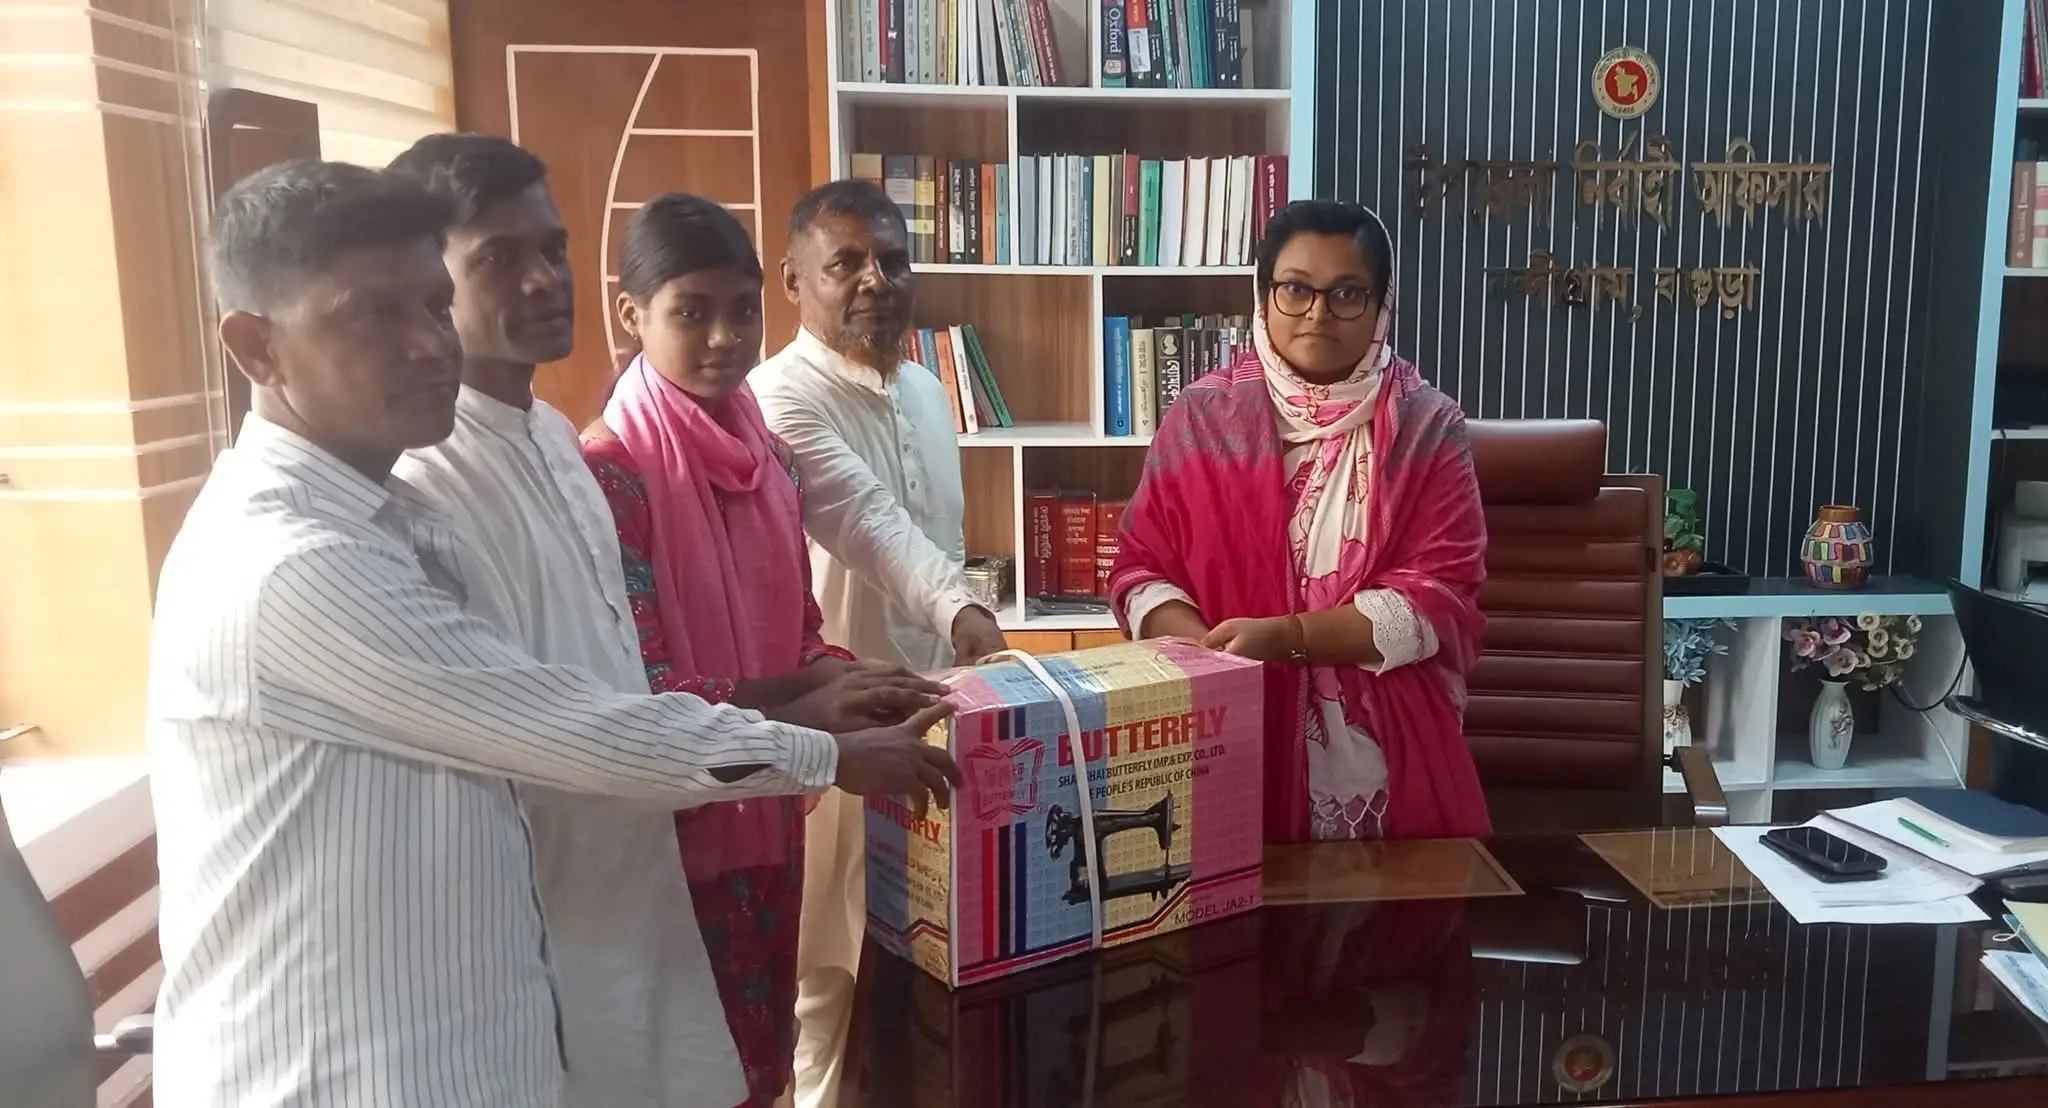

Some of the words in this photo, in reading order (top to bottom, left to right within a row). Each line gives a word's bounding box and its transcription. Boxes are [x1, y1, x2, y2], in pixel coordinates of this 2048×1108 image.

[1108, 7, 1122, 54] Oxford
[1690, 136, 1832, 231] অফিসার
[1652, 263, 1761, 319] বগুড়া
[1057, 705, 1228, 768] BUTTERFLY
[1058, 767, 1105, 788] SHAHAI
[1106, 758, 1152, 779] BUTTERFLY
[1134, 771, 1172, 790] REPUBLIC
[1173, 769, 1184, 782] OF
[1185, 764, 1209, 780] CHINA
[1174, 904, 1218, 925] MODEL
